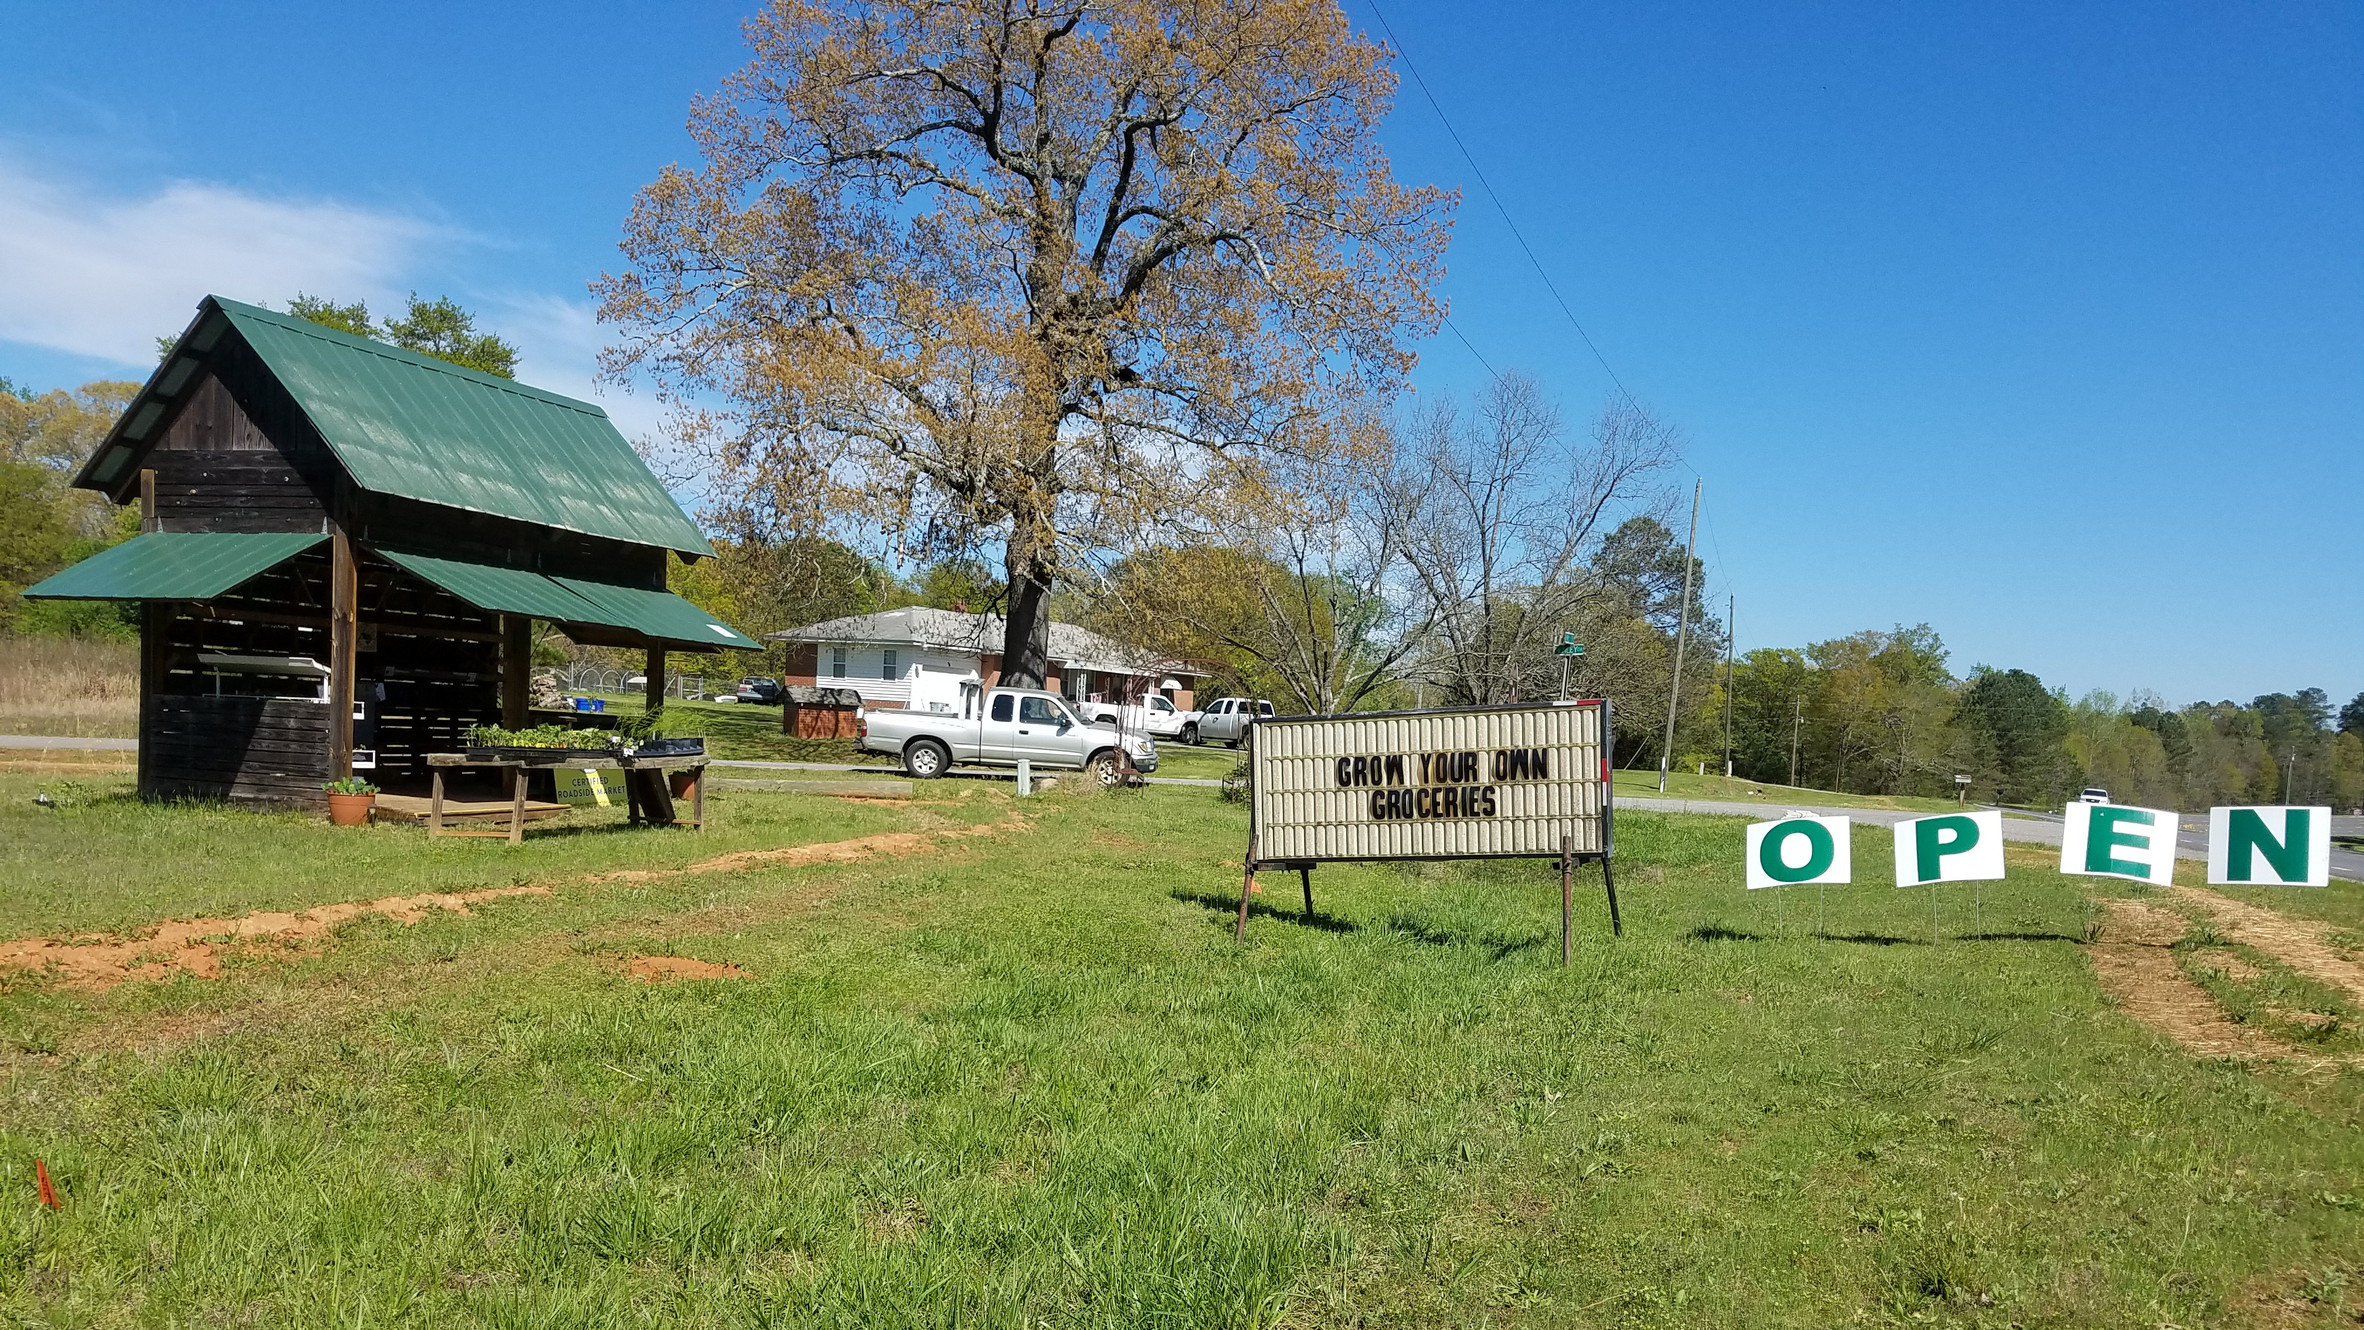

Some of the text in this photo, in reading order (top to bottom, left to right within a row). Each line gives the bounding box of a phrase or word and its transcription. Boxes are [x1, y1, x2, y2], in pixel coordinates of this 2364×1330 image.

[1337, 748, 1548, 787] GROW YOUR OWN
[558, 786, 625, 798] ROADSIDE MARKET
[572, 777, 609, 787] CERTIFIED
[1372, 785, 1496, 820] GROCERIES
